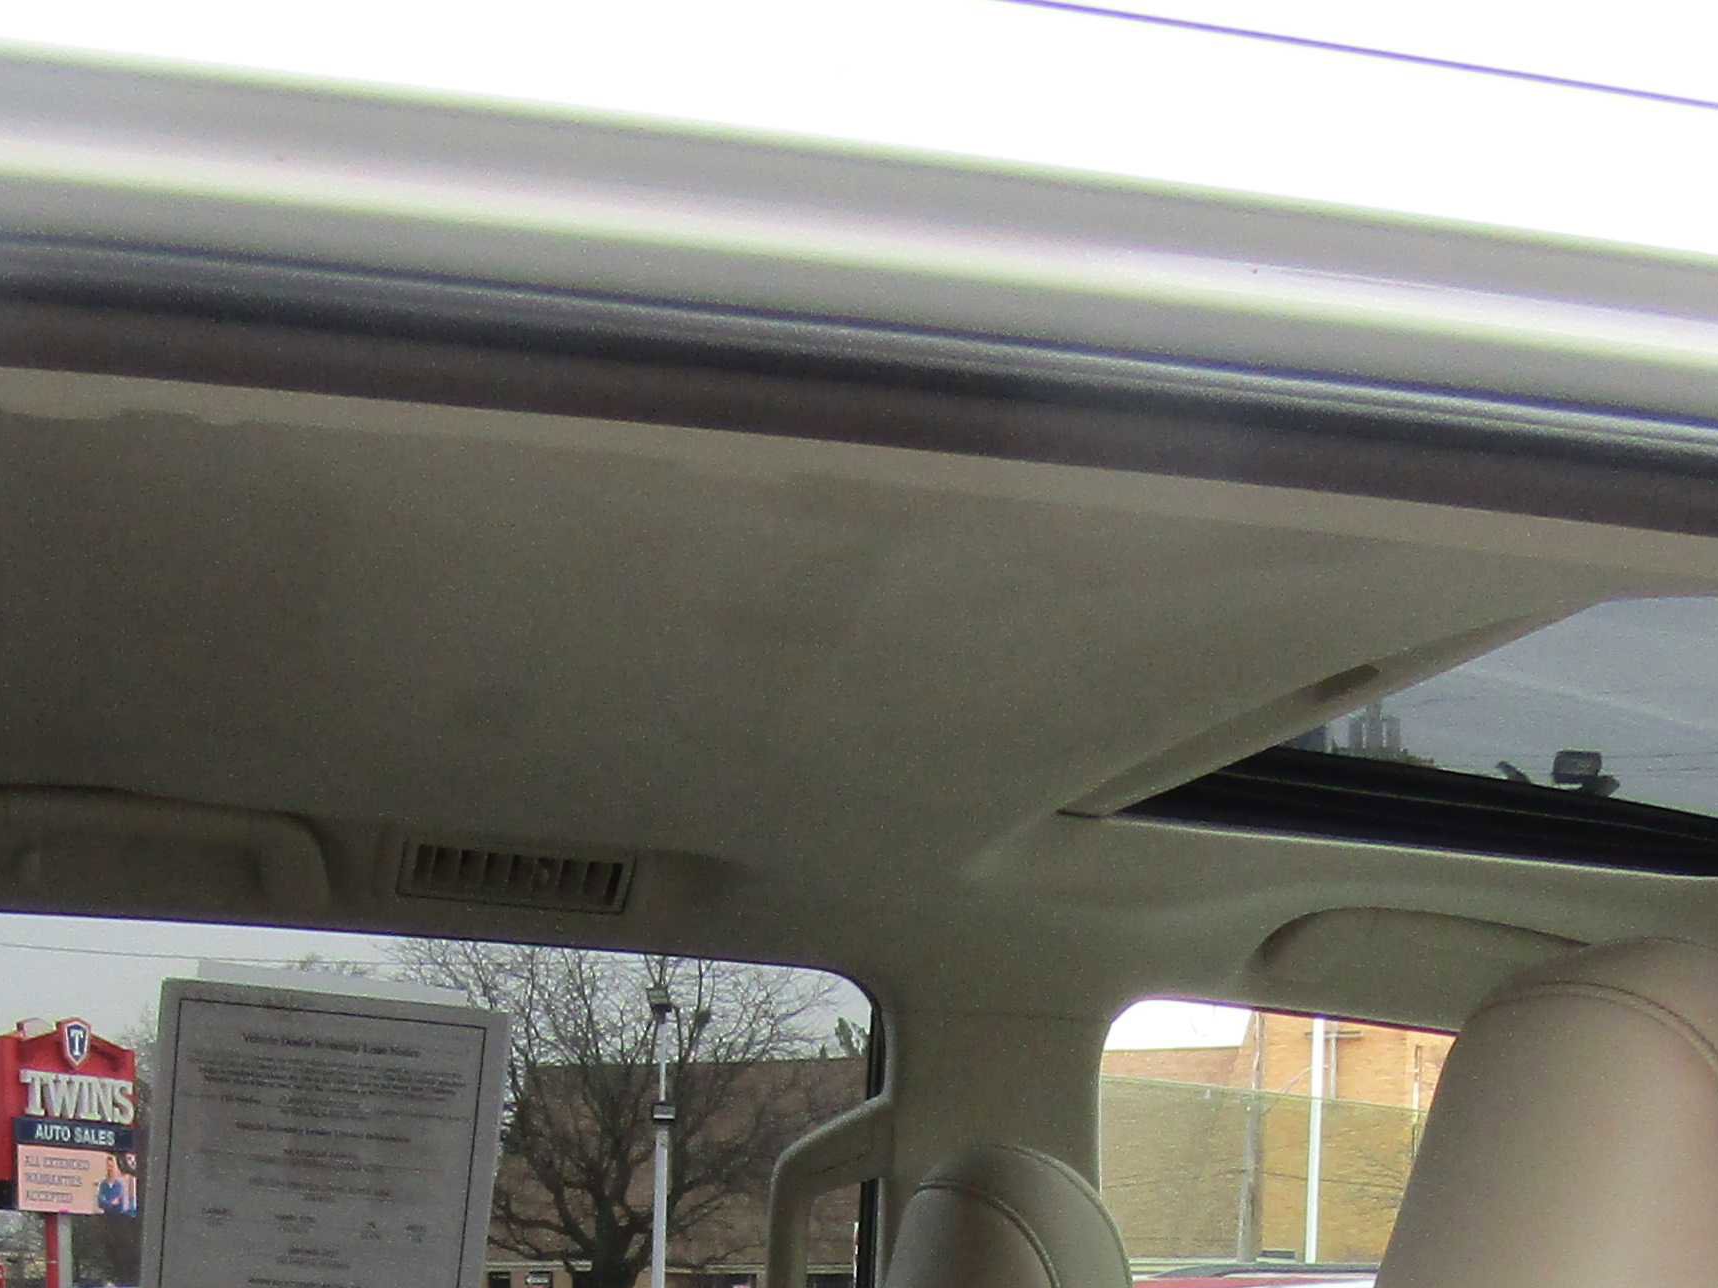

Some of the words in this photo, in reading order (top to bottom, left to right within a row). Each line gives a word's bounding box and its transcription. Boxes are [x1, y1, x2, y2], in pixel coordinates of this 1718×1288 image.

[19, 1069, 134, 1124] TWINS
[35, 1124, 71, 1142] AUTO
[74, 1127, 115, 1146] SALES
